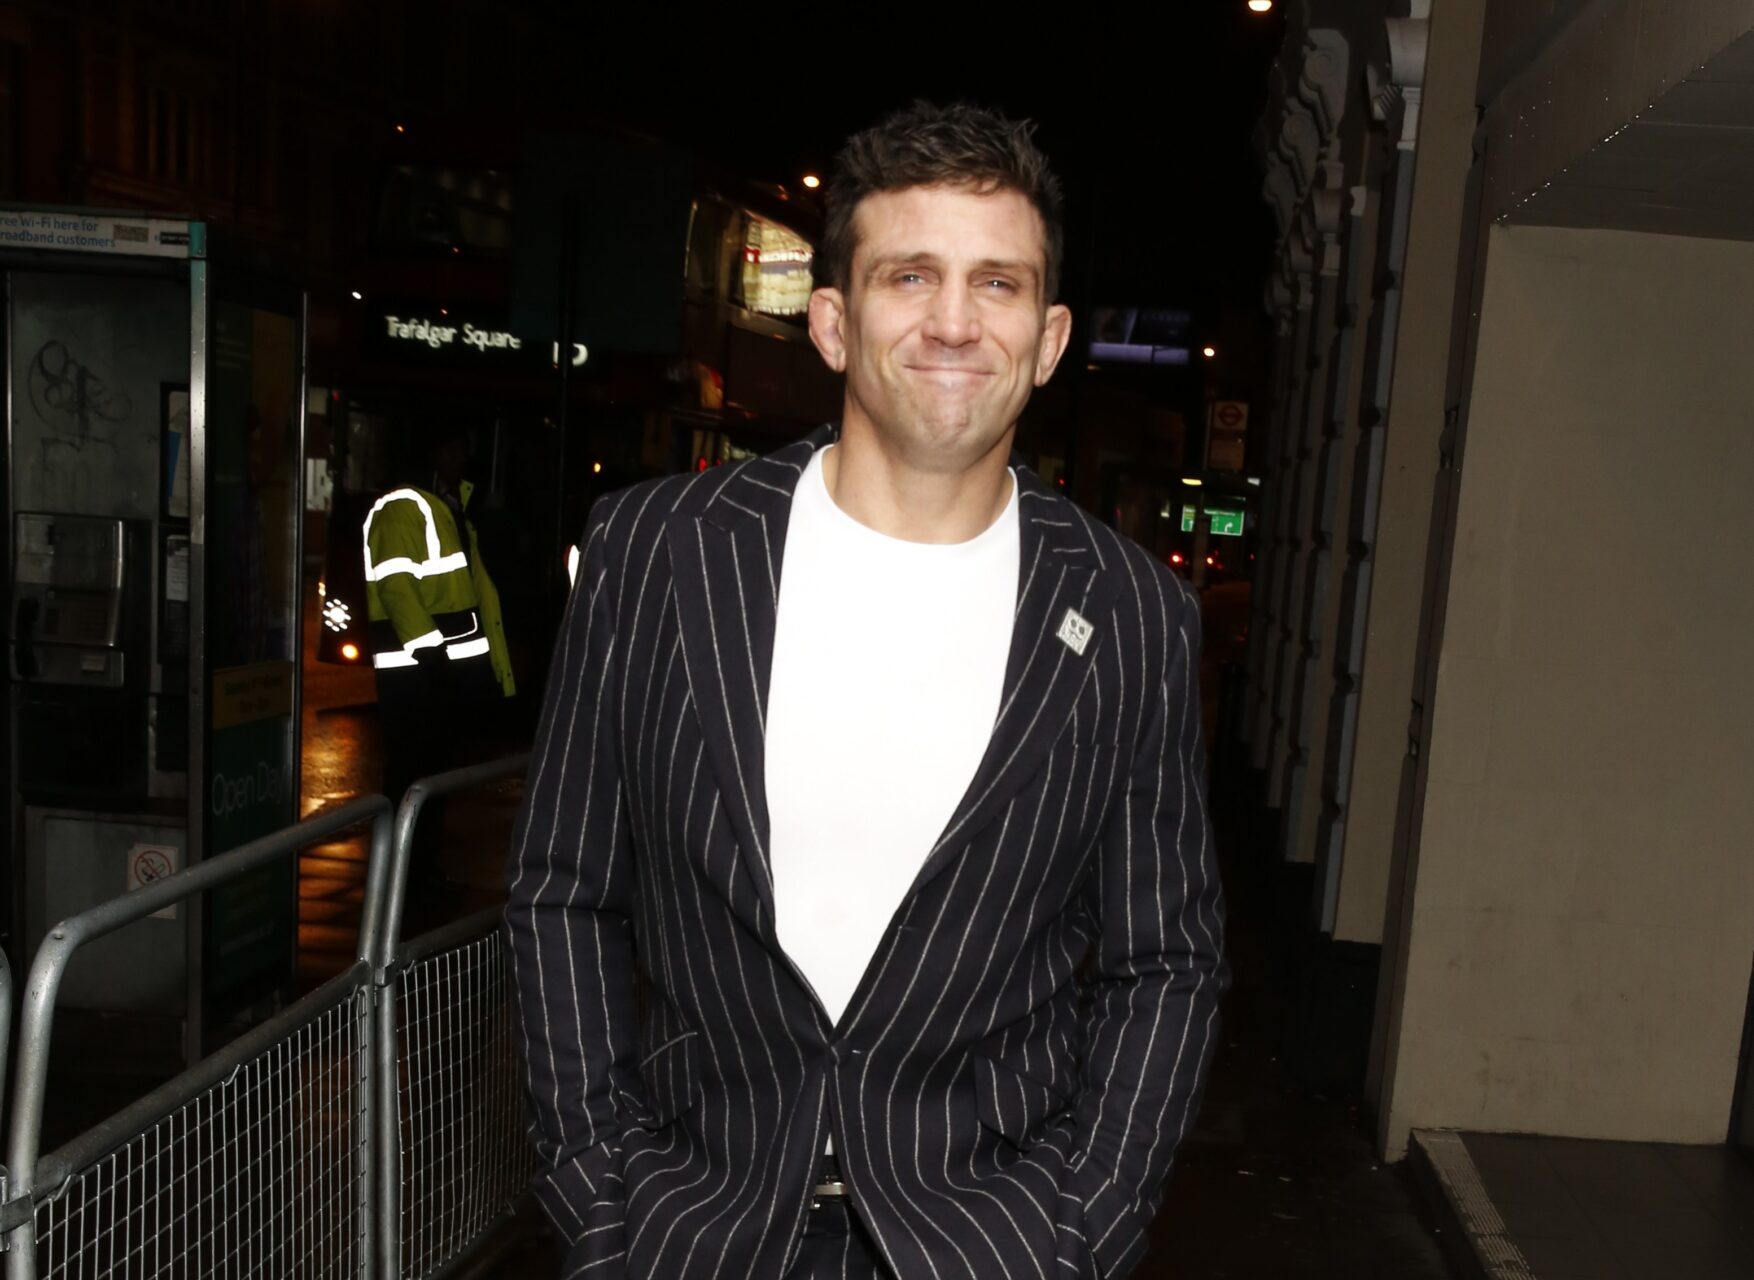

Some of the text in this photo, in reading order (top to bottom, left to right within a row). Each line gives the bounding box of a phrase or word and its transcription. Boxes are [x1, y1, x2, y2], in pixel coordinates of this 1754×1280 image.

[0, 215, 99, 232] ree Wi-Fi here for
[0, 228, 116, 248] roadband customers
[384, 315, 522, 352] Trafalgar Square
[211, 761, 287, 822] Open Day
